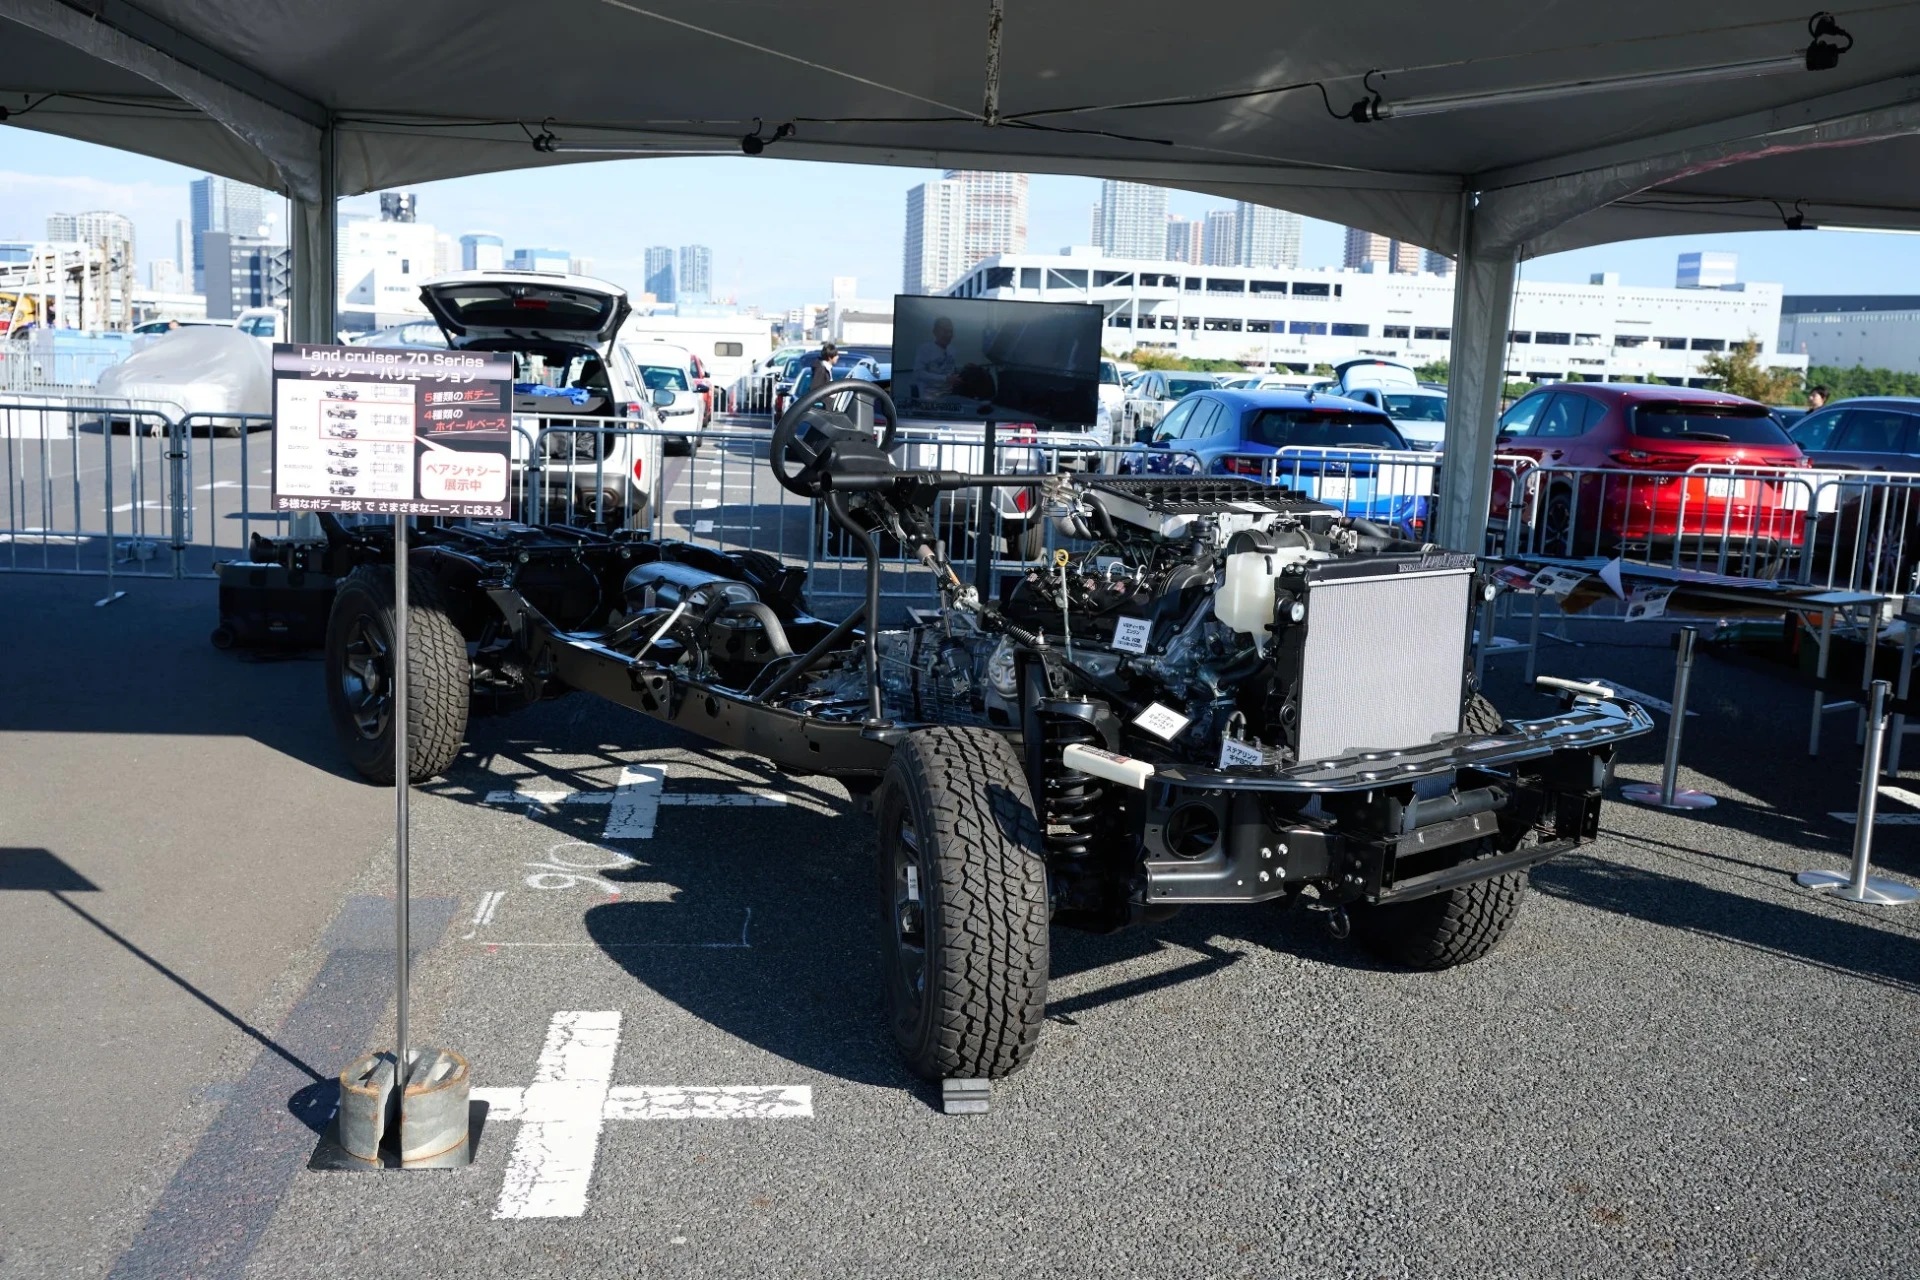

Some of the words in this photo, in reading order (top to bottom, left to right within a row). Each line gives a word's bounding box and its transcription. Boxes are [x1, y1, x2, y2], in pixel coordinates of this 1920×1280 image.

[302, 348, 341, 362] Land
[345, 351, 402, 365] cruiser
[406, 353, 429, 366] 70
[433, 353, 485, 369] Series
[424, 389, 495, 404] 5種類のボデー
[424, 409, 464, 421] 4種類の
[435, 418, 506, 432] ホイールベース
[444, 478, 482, 492] 展示中
[278, 497, 362, 512] 多様なボデー形状
[378, 502, 460, 515] さまざまなニーズ
[463, 504, 505, 517] に応える
[1226, 745, 1259, 762] ステアリング
